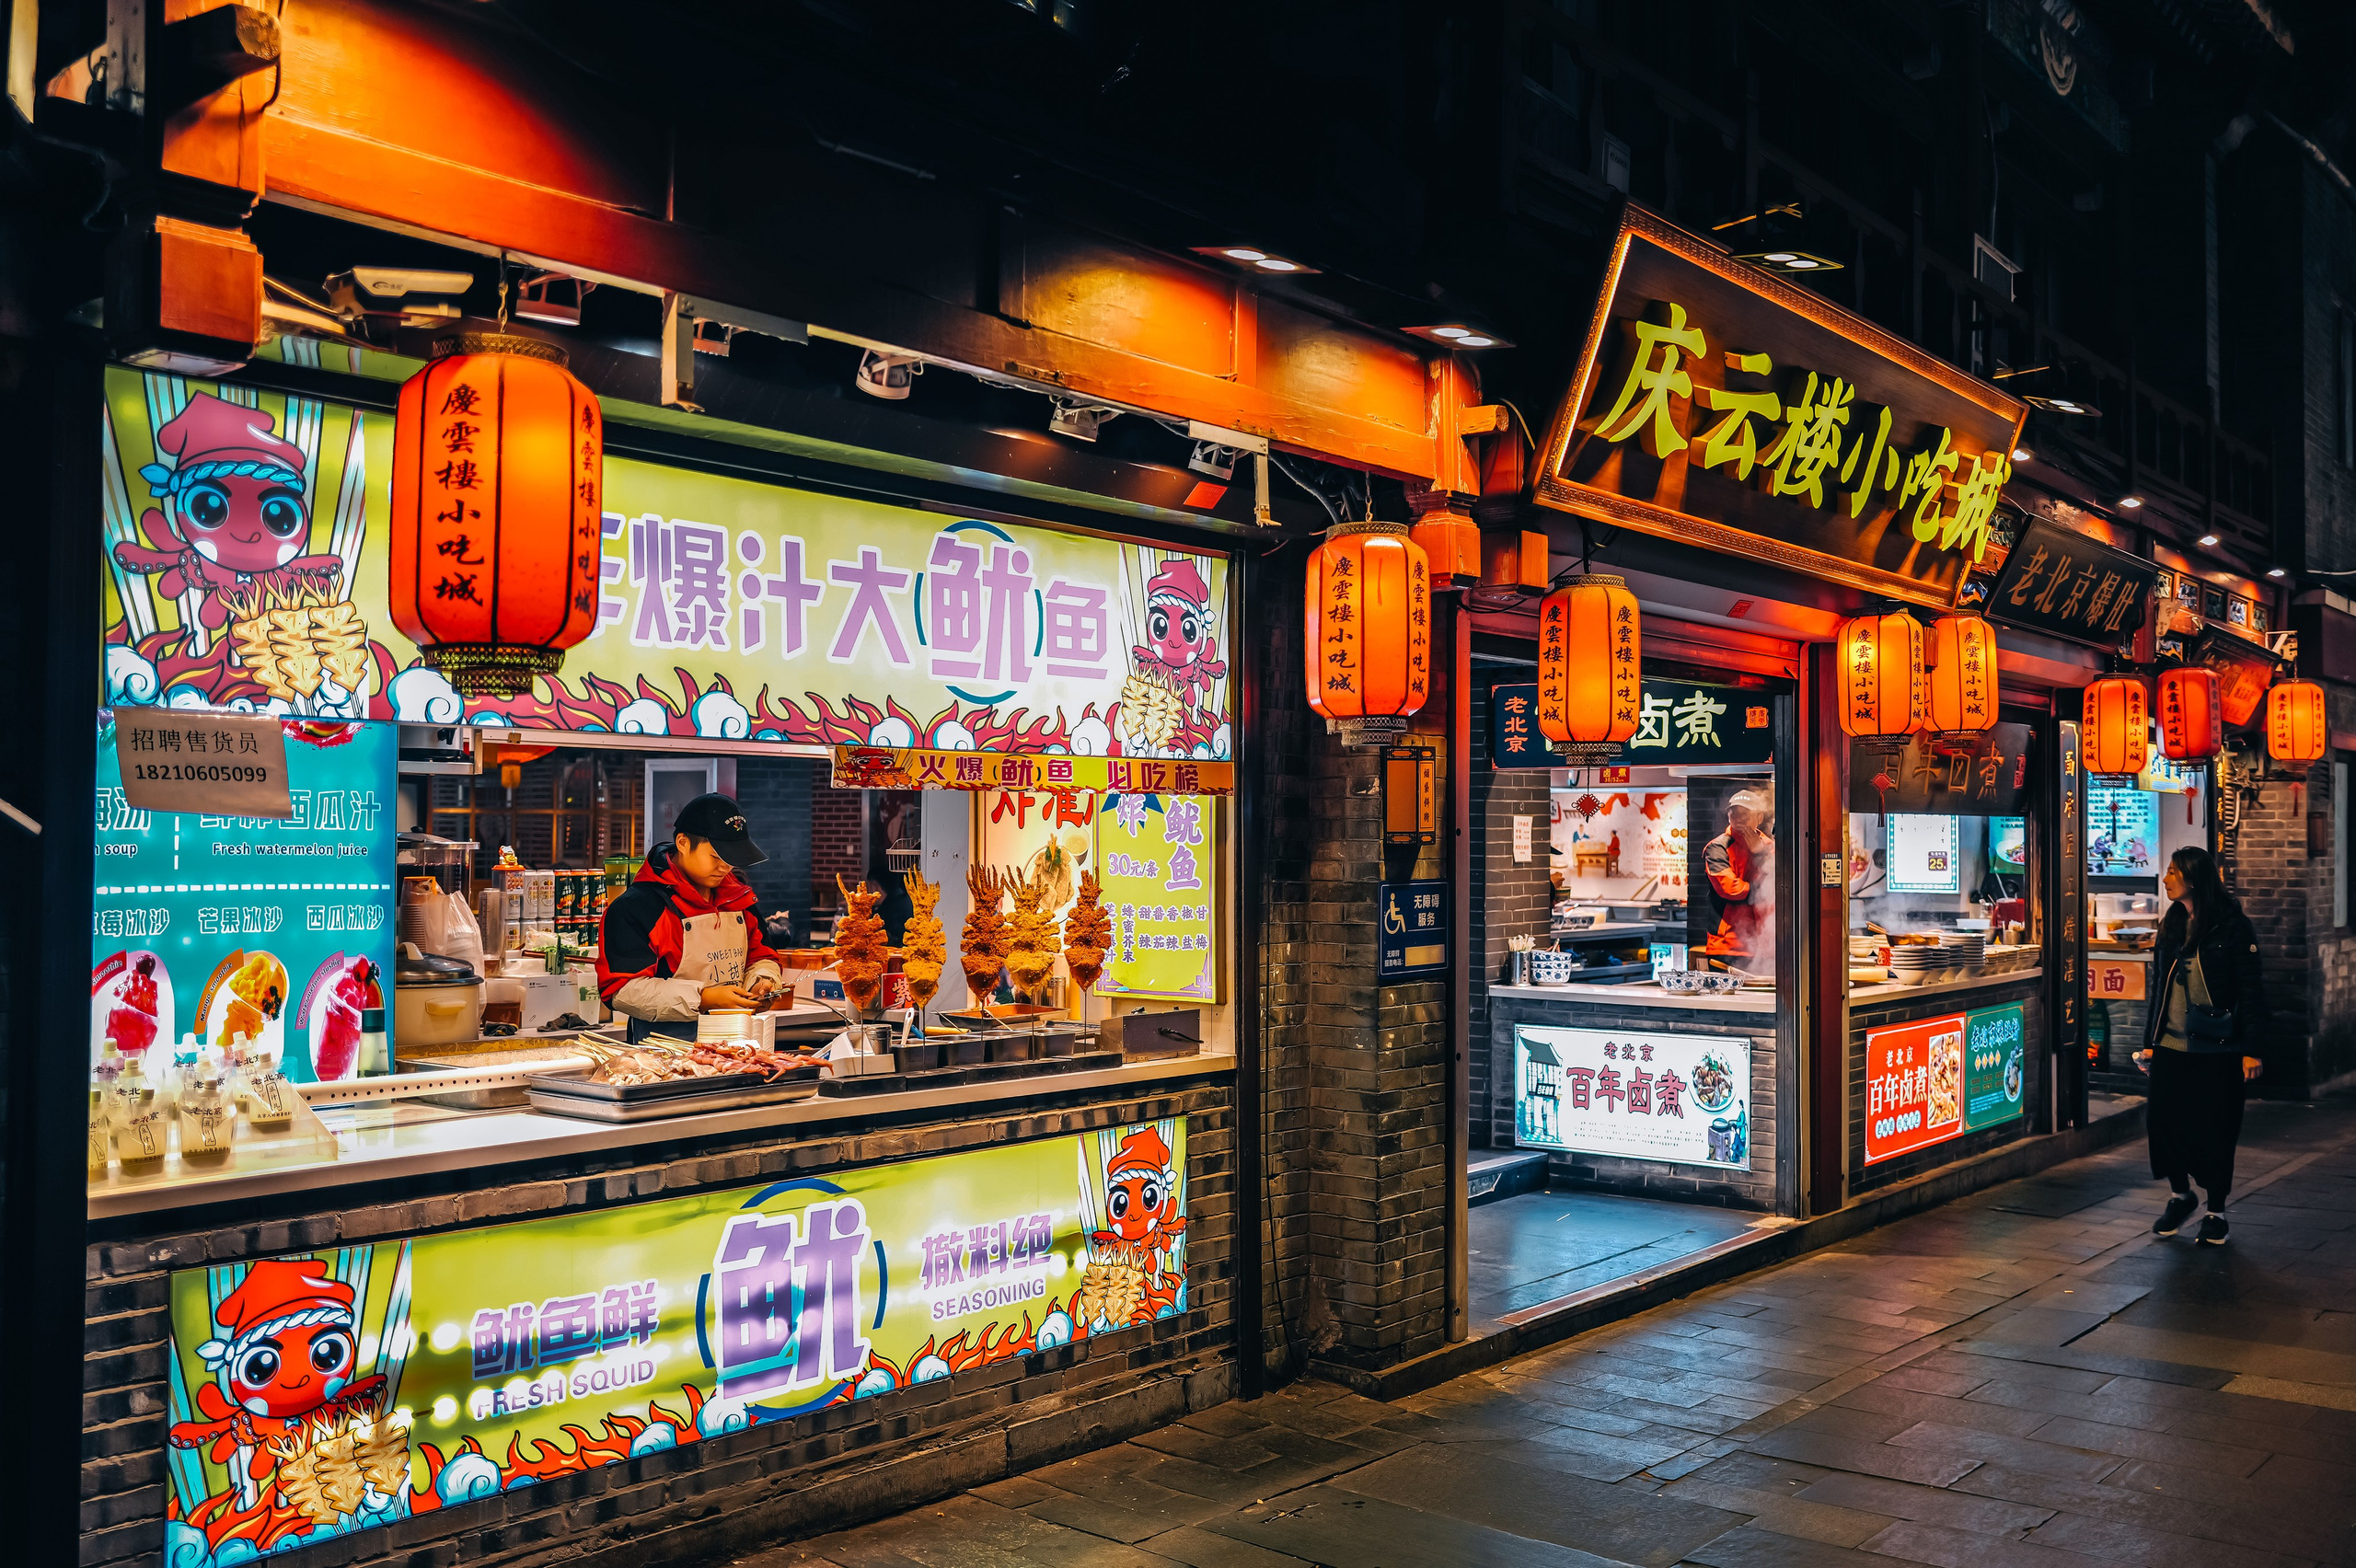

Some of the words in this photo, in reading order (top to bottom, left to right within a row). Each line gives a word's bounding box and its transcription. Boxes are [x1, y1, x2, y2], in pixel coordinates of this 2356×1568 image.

[1595, 302, 2012, 564] 庆云楼小吃城
[433, 383, 485, 607] 慶雲樓小吃城
[2005, 543, 2139, 633] 老北京爆肚
[1327, 556, 1356, 694] 慶雲樓小吃城
[1412, 560, 1426, 698] 慶雲樓小吃城
[1542, 605, 1564, 723] 慶雲樓小吃城
[1615, 605, 1635, 725] 慶雲樓小吃城
[1854, 629, 1875, 721] 慶雲樓小吃城
[1964, 632, 1984, 716] 慶雲樓小吃城
[131, 727, 259, 755] 招聘售货员
[1504, 696, 1528, 753] 老北京
[135, 763, 267, 783] 18210605099
[918, 755, 1073, 787] 火爆鱿鱼
[1108, 761, 1199, 792] 必吃榜
[200, 789, 381, 831] 西瓜汁
[104, 843, 138, 859] soup
[213, 842, 250, 856] Fresh
[255, 842, 333, 856] watermelon
[337, 843, 368, 859] juice
[1163, 794, 1203, 890] 鱿鱼
[1108, 853, 1159, 878] 30元/条
[93, 907, 170, 937] 莓冰沙
[198, 905, 283, 934] 芒果冰沙
[307, 905, 385, 930] 西瓜冰沙
[1414, 894, 1439, 909] 无障碍
[1417, 912, 1435, 927] 服务
[1121, 904, 1135, 963] 蜂蜜芥末
[1138, 905, 1151, 950] 甜辣
[1152, 905, 1165, 950] 番茄
[1166, 905, 1179, 951] 香辣
[1181, 905, 1194, 950] 椒盐
[1195, 905, 1208, 950] 甘梅
[91, 960, 122, 986] smoothie
[707, 949, 732, 963] SWEET
[200, 996, 212, 1022] Mango
[210, 961, 233, 993] smoothie
[1604, 1042, 1654, 1062] 老北京
[1886, 1046, 1913, 1067] 老北京
[193, 1078, 225, 1089] 老京
[251, 1072, 285, 1085] 老北京
[1566, 1065, 1688, 1120] 百年卤煮
[1869, 1066, 1928, 1116] 百年卤煮
[191, 1107, 223, 1115] 老北京
[722, 1205, 865, 1400] 鱿
[933, 1278, 1045, 1320] SEASONING
[473, 1280, 659, 1378] 鱿鱼鲜
[476, 1381, 565, 1419] FRESH
[571, 1359, 655, 1398] SQUID
